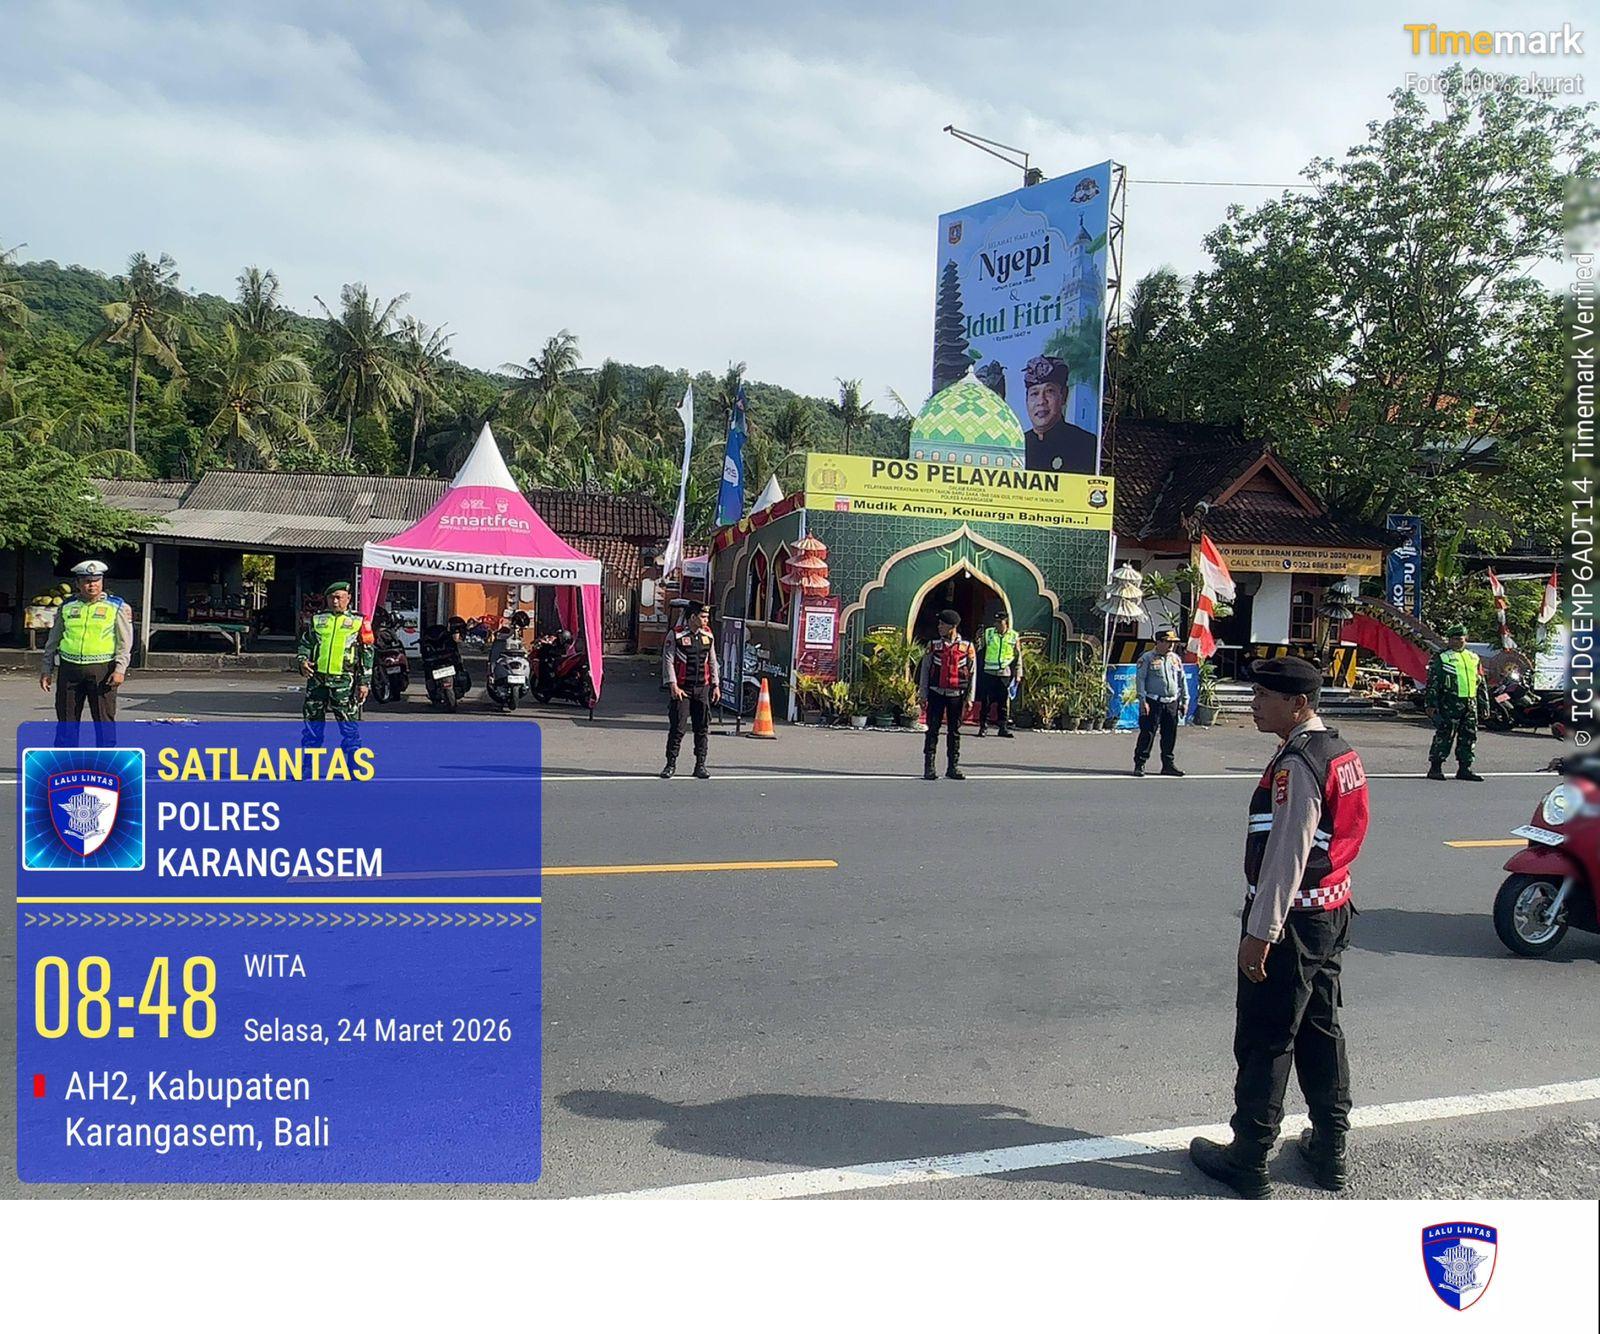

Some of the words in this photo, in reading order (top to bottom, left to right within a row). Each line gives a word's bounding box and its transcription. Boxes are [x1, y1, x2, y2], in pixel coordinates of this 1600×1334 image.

[978, 236, 1050, 283] Nyepi
[1009, 288, 1020, 301] &
[966, 308, 1005, 339] Idul
[1012, 296, 1062, 330] Fitri
[872, 460, 919, 481] POS
[927, 464, 1059, 492] PELAYANAN
[439, 513, 530, 530] smartfren
[853, 500, 898, 511] Mudik
[902, 504, 947, 516] Aman,
[952, 507, 1014, 520] Keluarga
[1019, 512, 1089, 525] Bahagia...!
[1230, 559, 1249, 567] CALL
[1257, 549, 1291, 557] LEBARAN
[391, 554, 578, 579] www.smartfren.com
